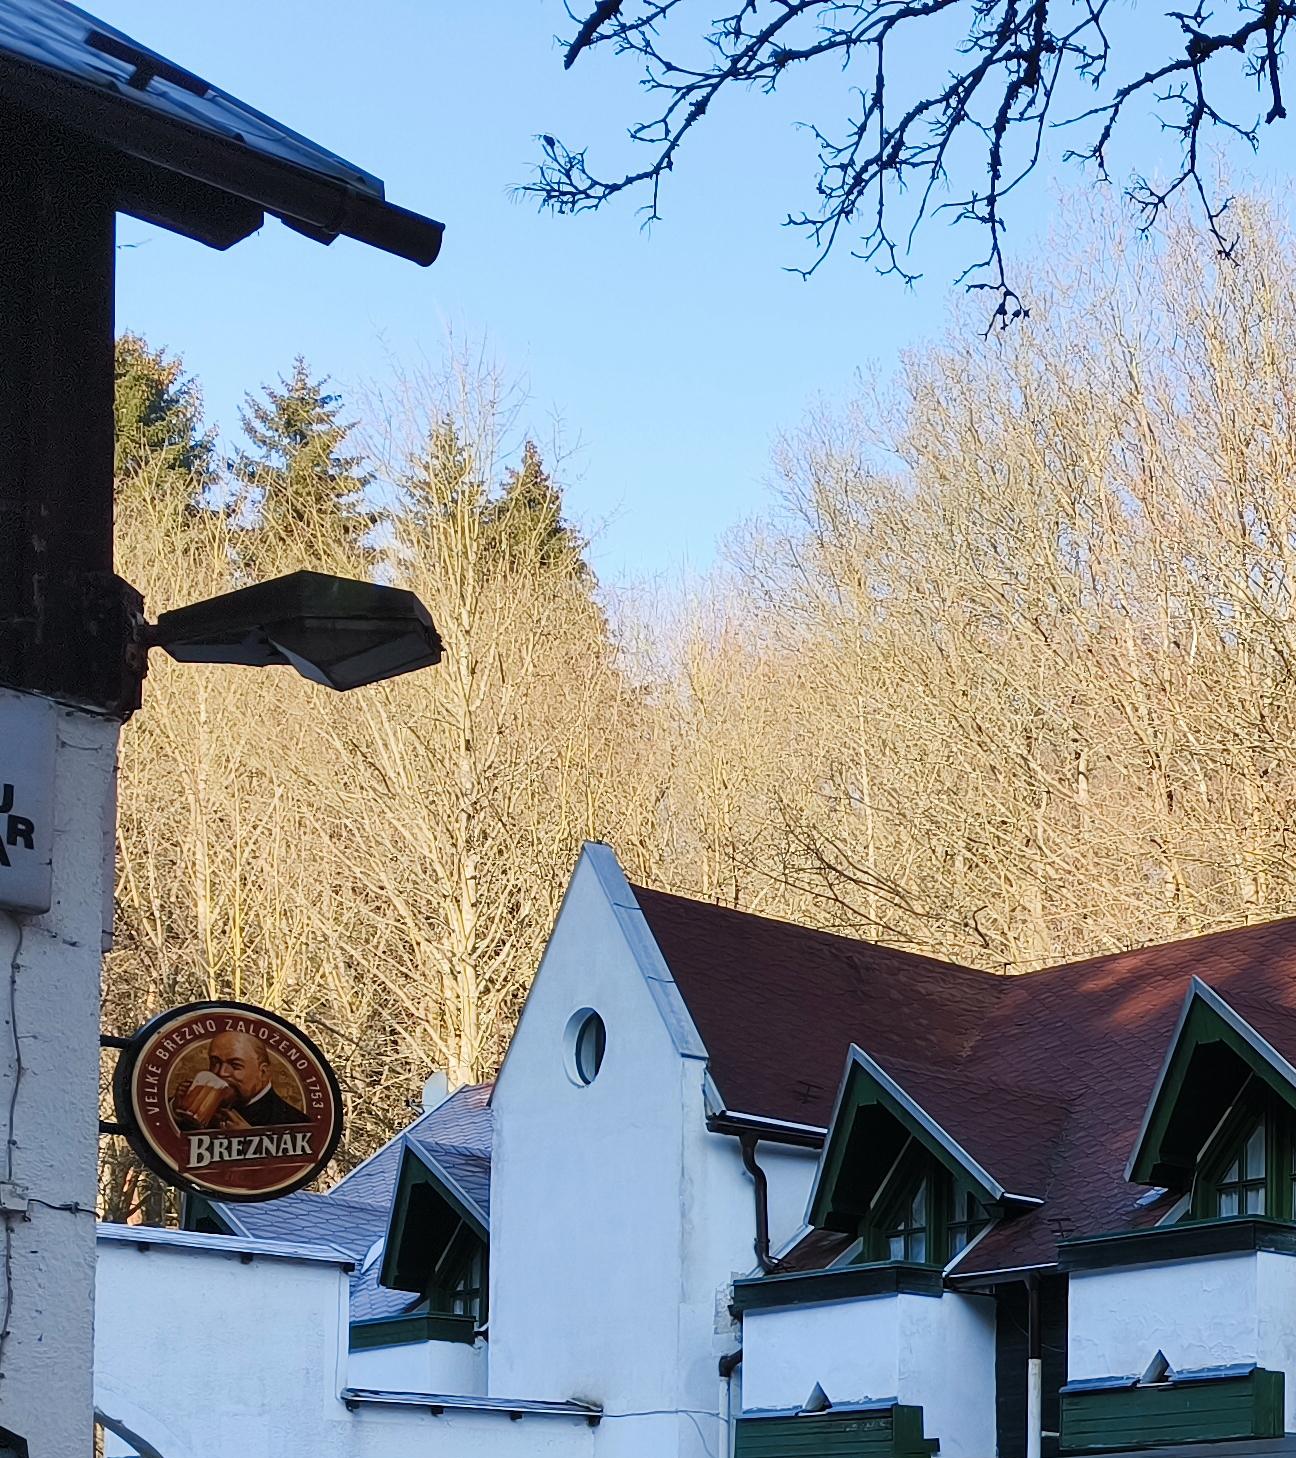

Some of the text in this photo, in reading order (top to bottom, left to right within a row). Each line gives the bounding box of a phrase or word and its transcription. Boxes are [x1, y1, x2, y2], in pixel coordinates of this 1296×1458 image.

[145, 1018, 325, 1116] VELKÉ BŘEZNO ZALOŽENO 1753
[186, 1129, 313, 1169] BŘEZŇÁK
